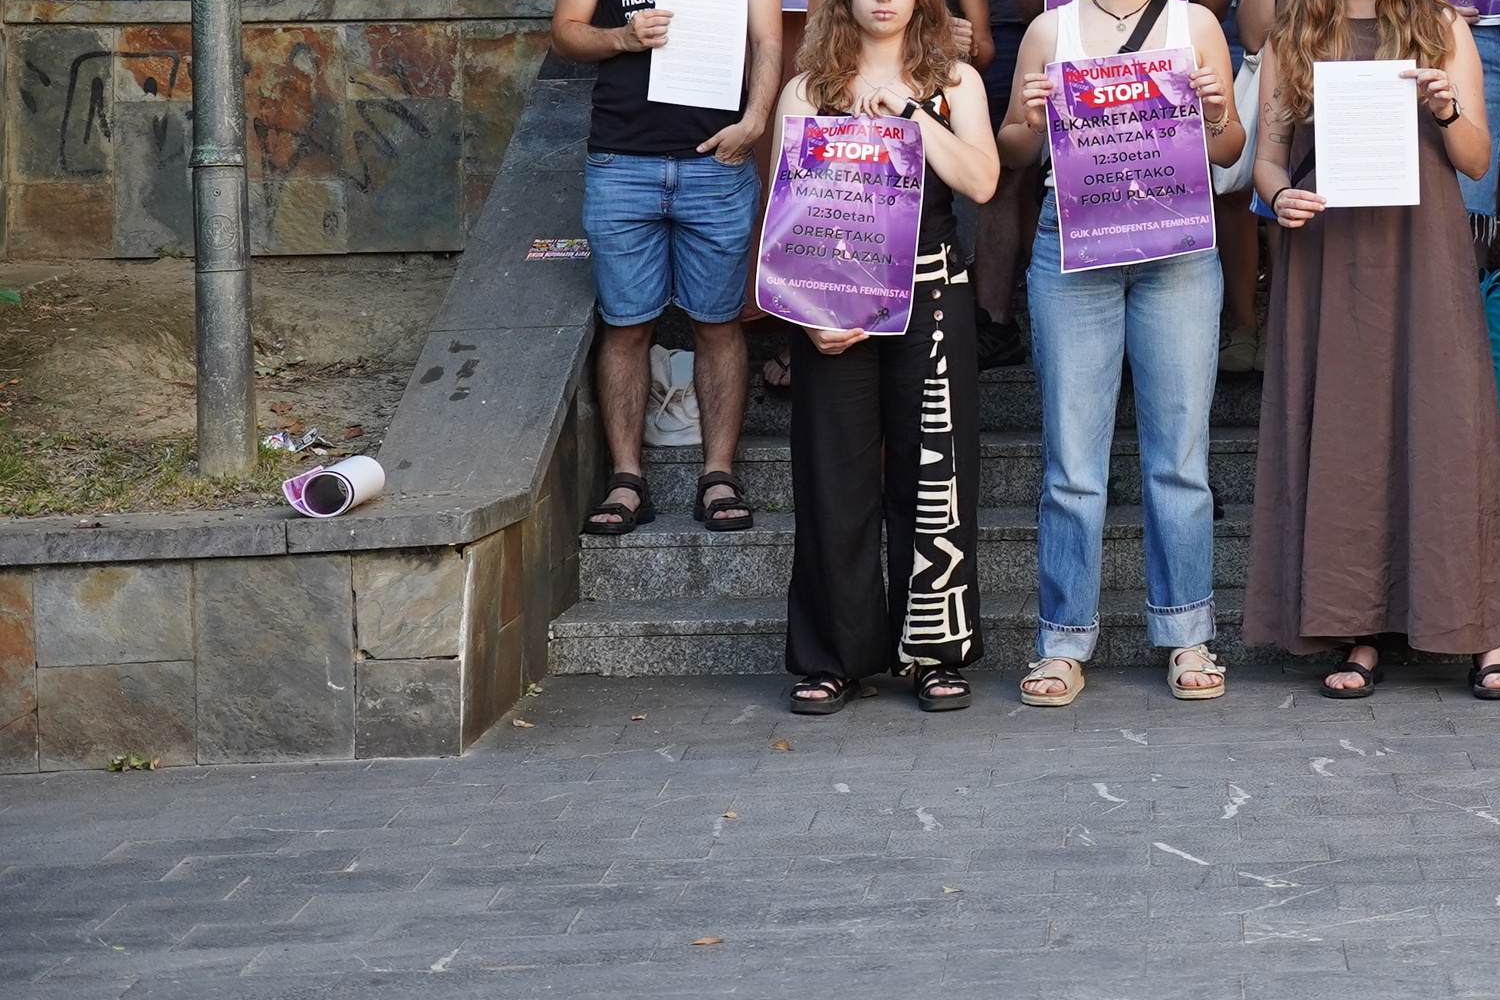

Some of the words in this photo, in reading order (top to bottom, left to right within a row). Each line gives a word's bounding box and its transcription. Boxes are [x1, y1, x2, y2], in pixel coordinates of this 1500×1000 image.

[1094, 81, 1150, 105] STOP!
[1053, 104, 1199, 133] ELKARRETARATZEA
[1078, 130, 1155, 148] MAIATZAK
[1159, 127, 1176, 139] 30
[822, 142, 879, 162] STOP!
[1093, 149, 1160, 166] 12:30etan
[779, 168, 920, 190] ELKARRETARATZEA
[1084, 166, 1175, 186] ORERETAKO
[796, 187, 873, 204] MAIATZAK
[878, 194, 896, 206] 30
[1127, 184, 1186, 200] PLAZAN
[807, 206, 875, 224] 12:30etan
[792, 224, 886, 244] ORERETAKO
[1070, 229, 1090, 239] GUK
[1092, 221, 1159, 236] AUTODEFENTSA
[1161, 215, 1210, 228] FEMINISTA!
[832, 248, 892, 264] PLAZAN
[767, 276, 786, 286] GUK
[788, 279, 858, 294] AUTODEFENTSA
[860, 286, 909, 299] FEMINISTA!
